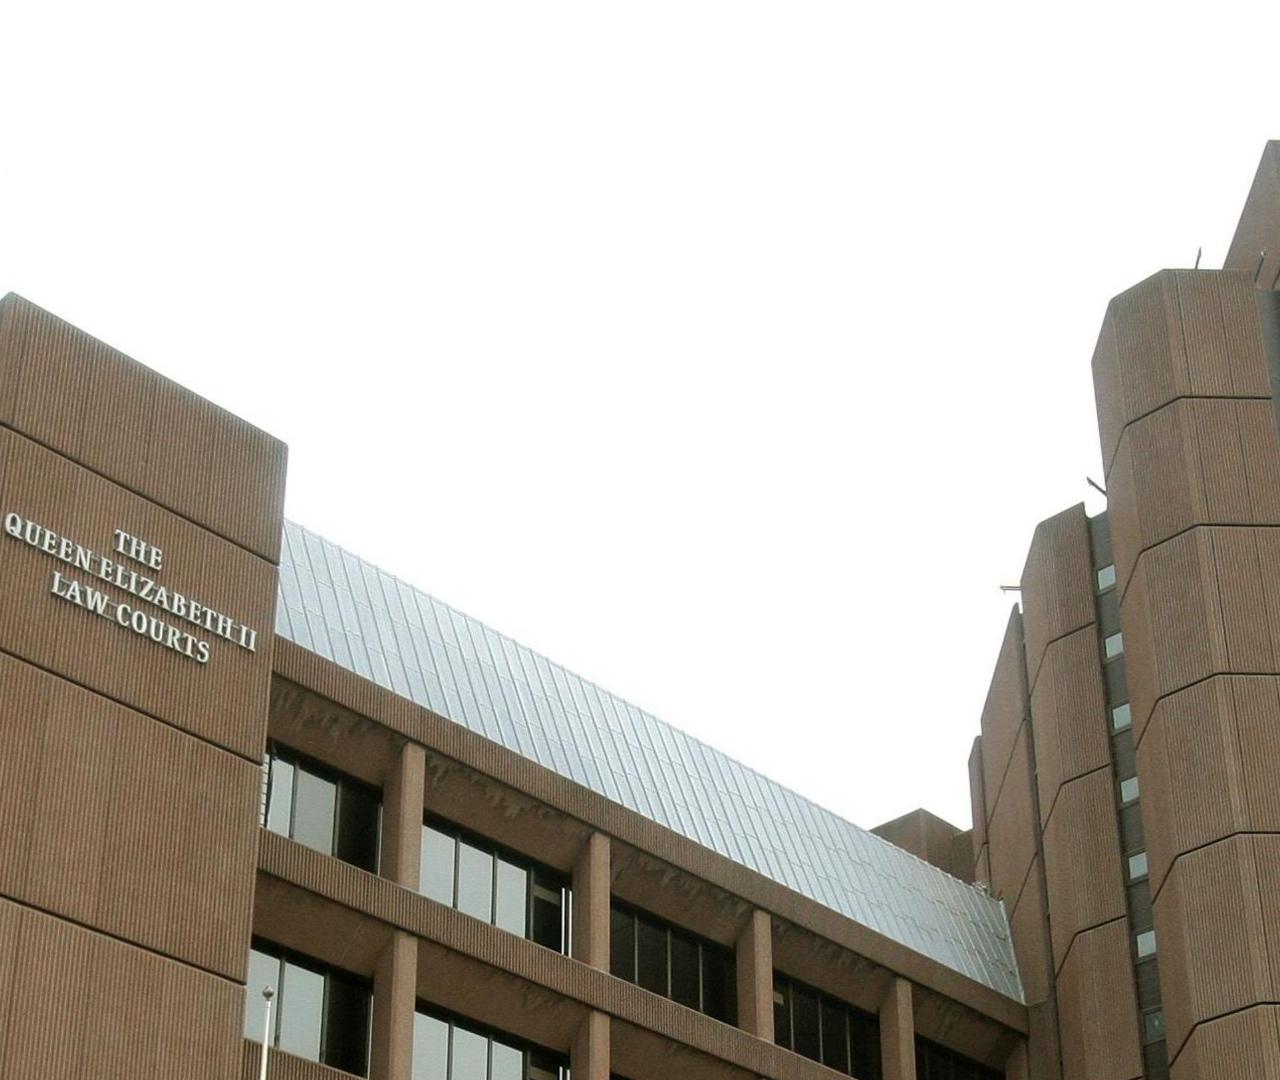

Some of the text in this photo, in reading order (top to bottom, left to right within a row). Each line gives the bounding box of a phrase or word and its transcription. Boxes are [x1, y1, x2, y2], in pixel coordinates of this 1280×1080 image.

[4, 512, 258, 652] QUEEN ELIZABETH II
[114, 528, 163, 571] THE
[51, 571, 211, 664] LAW COURTS
